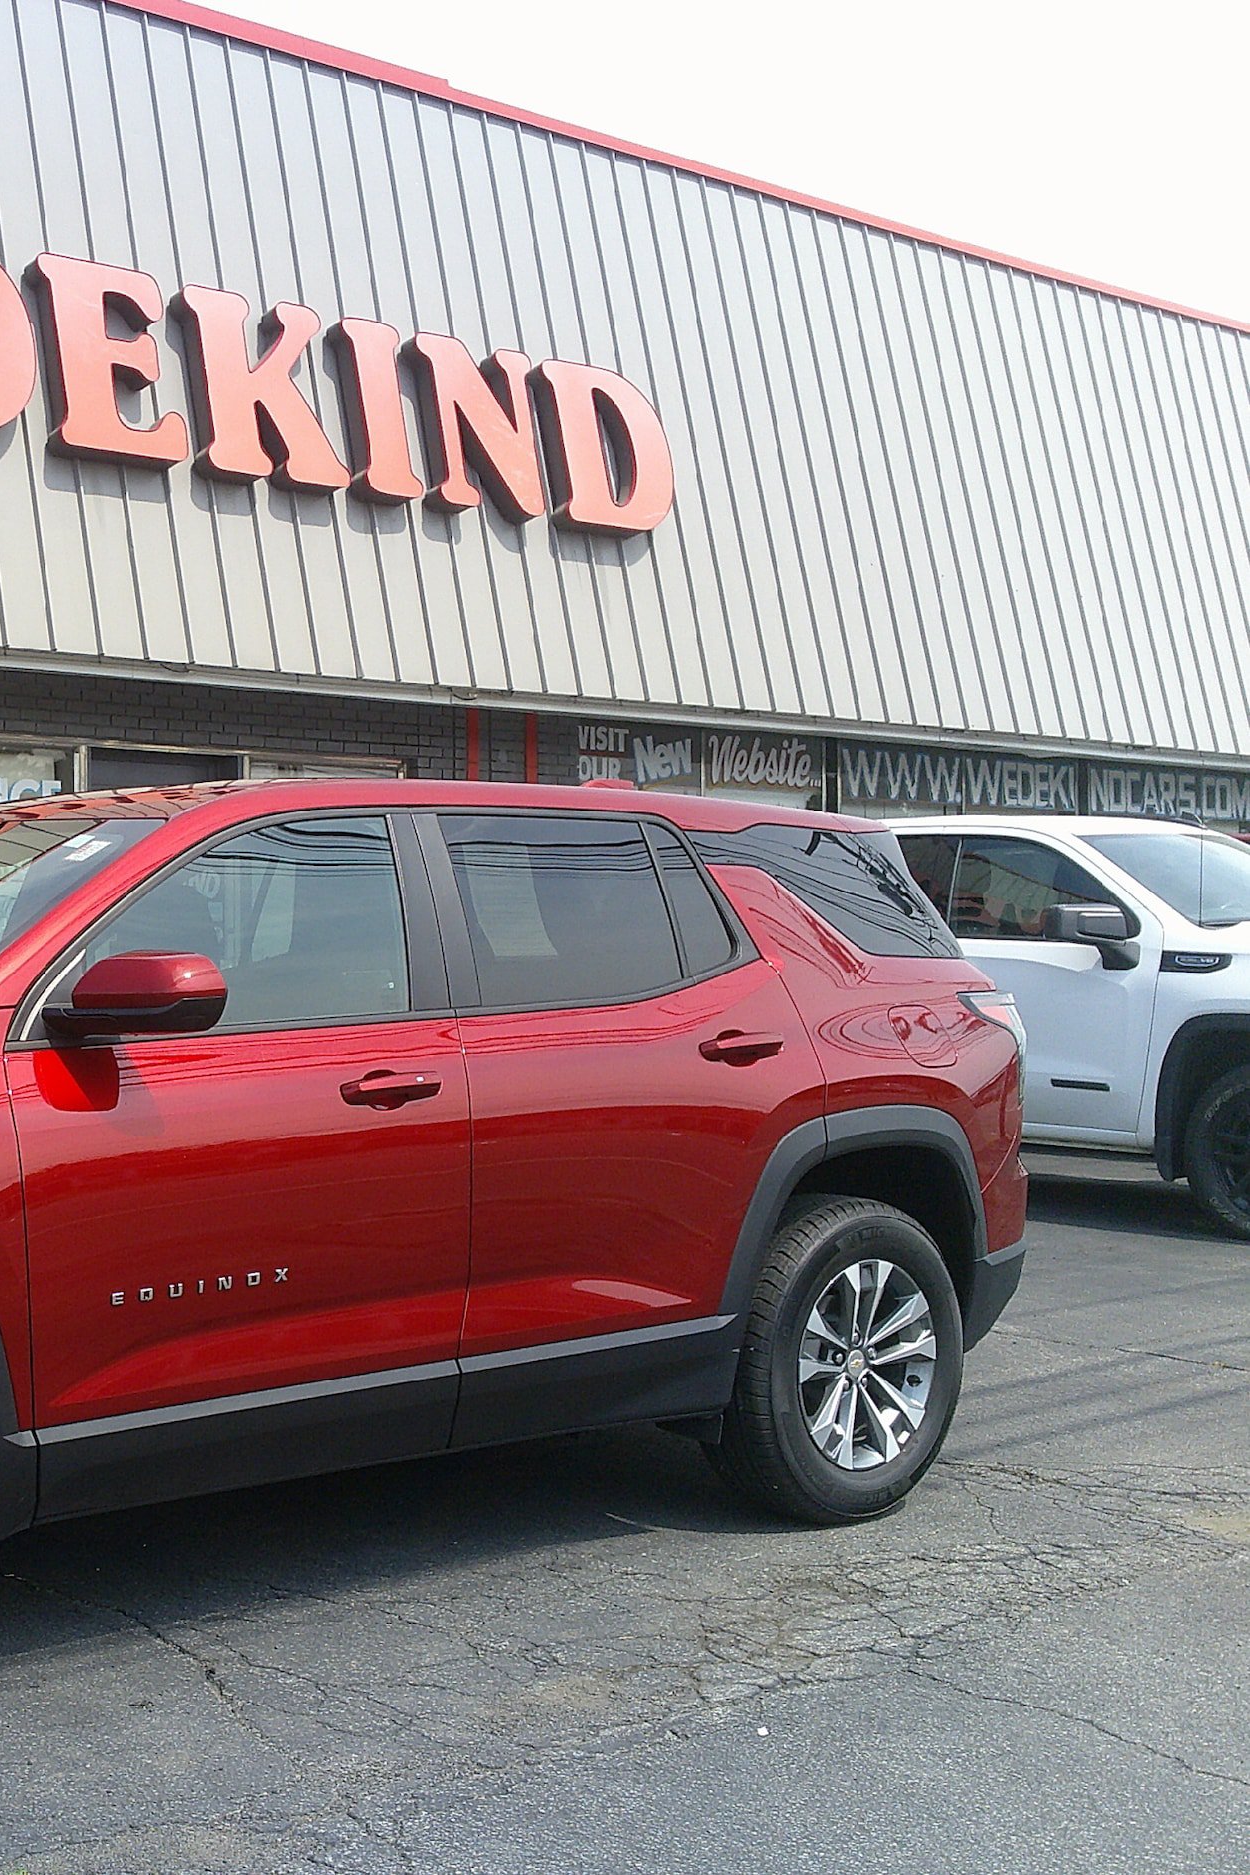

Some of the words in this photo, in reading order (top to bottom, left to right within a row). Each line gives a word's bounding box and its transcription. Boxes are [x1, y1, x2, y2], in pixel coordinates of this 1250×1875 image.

[577, 725, 630, 753] VISIT
[577, 755, 621, 781] OUR
[632, 735, 693, 784] New
[111, 1267, 289, 1306] EQUINOX
